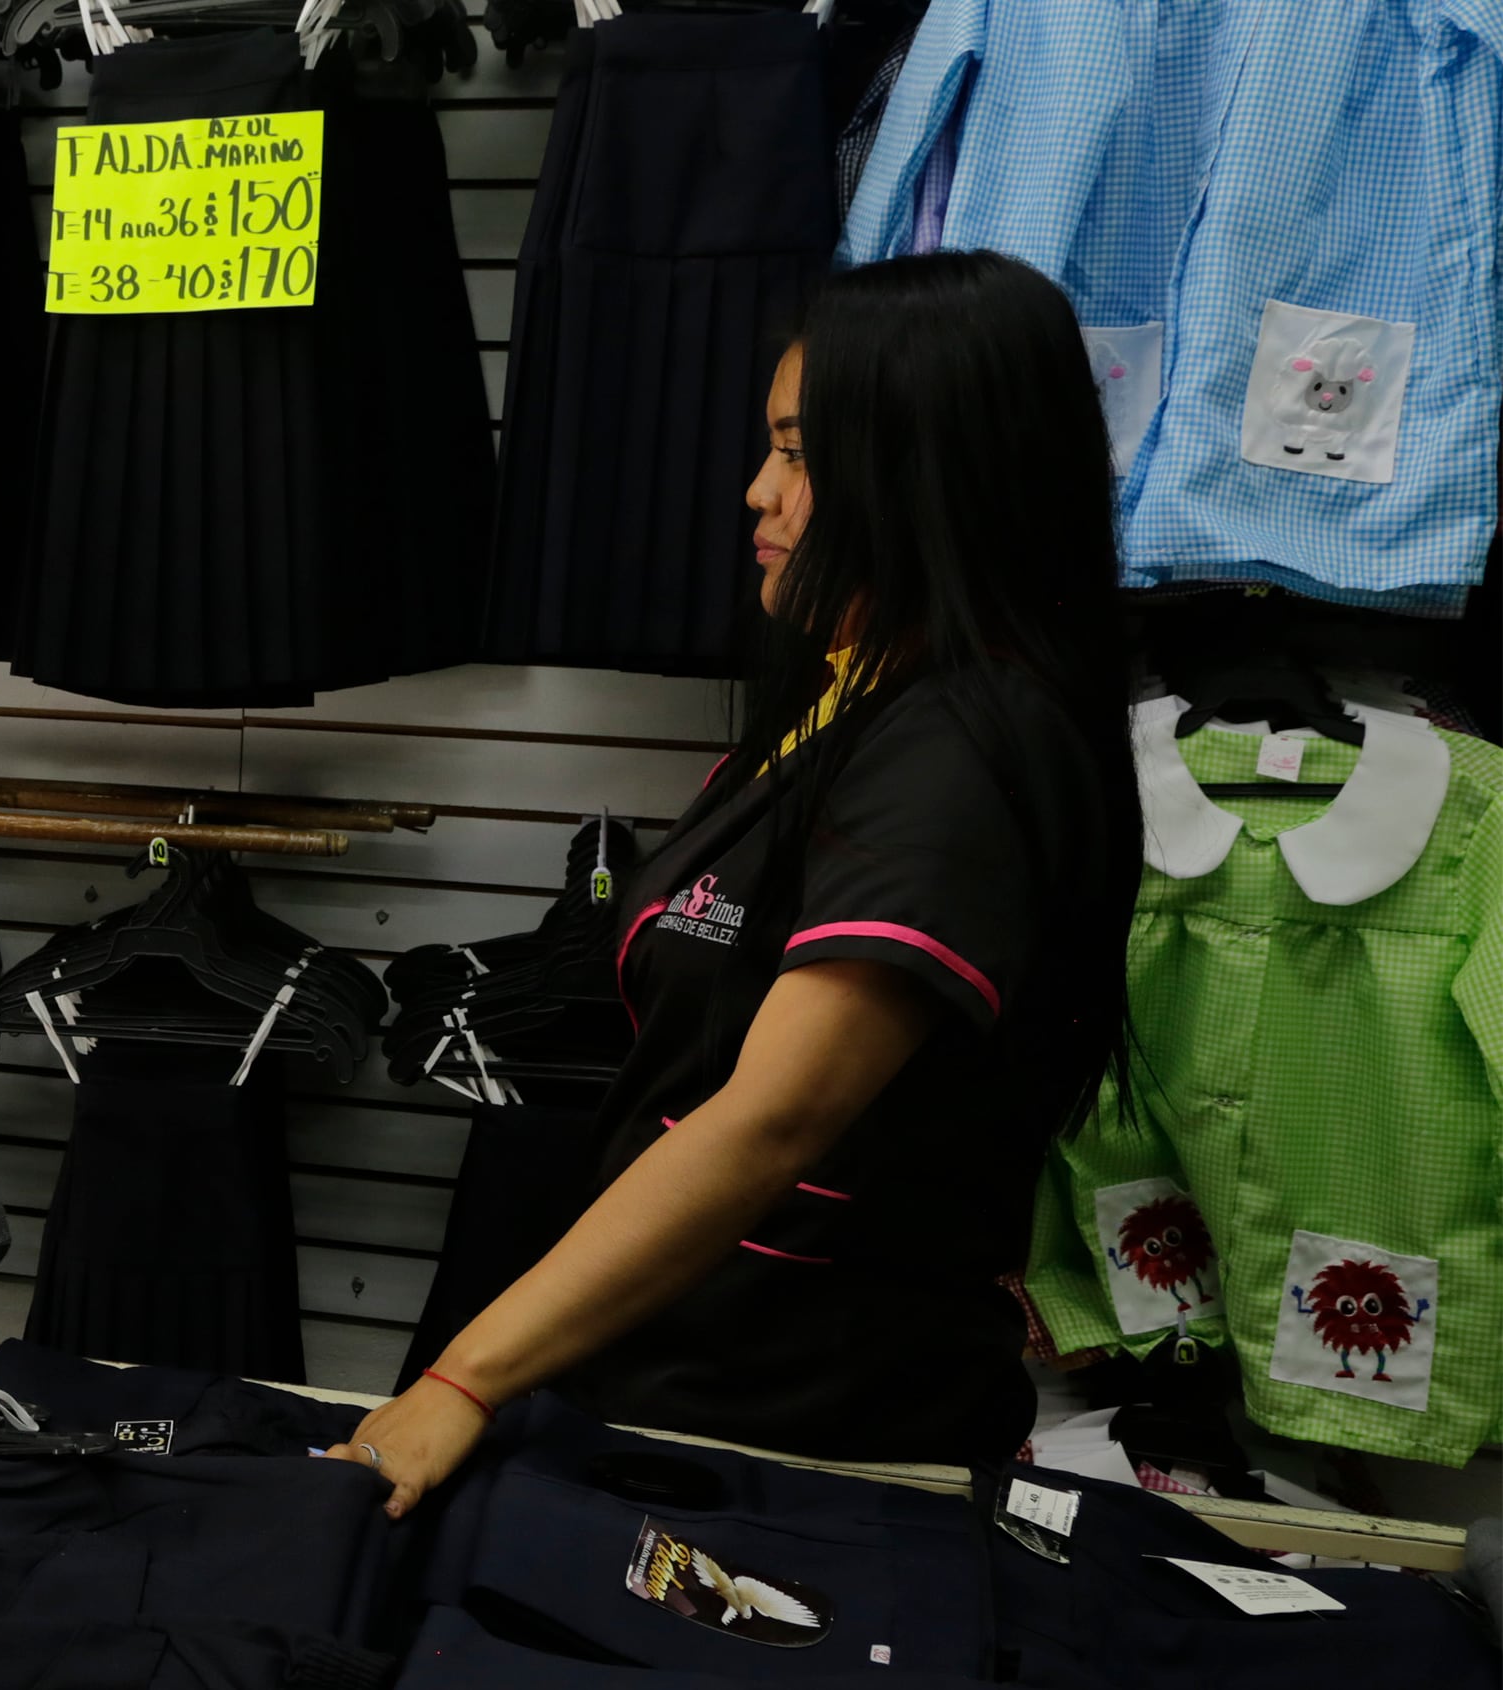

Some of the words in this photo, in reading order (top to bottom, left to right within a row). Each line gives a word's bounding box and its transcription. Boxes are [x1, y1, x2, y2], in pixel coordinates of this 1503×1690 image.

[208, 117, 278, 139] AZUL
[204, 138, 304, 169] MARINO
[158, 197, 199, 237] 36
[152, 843, 165, 858] 10
[683, 919, 699, 935] DE
